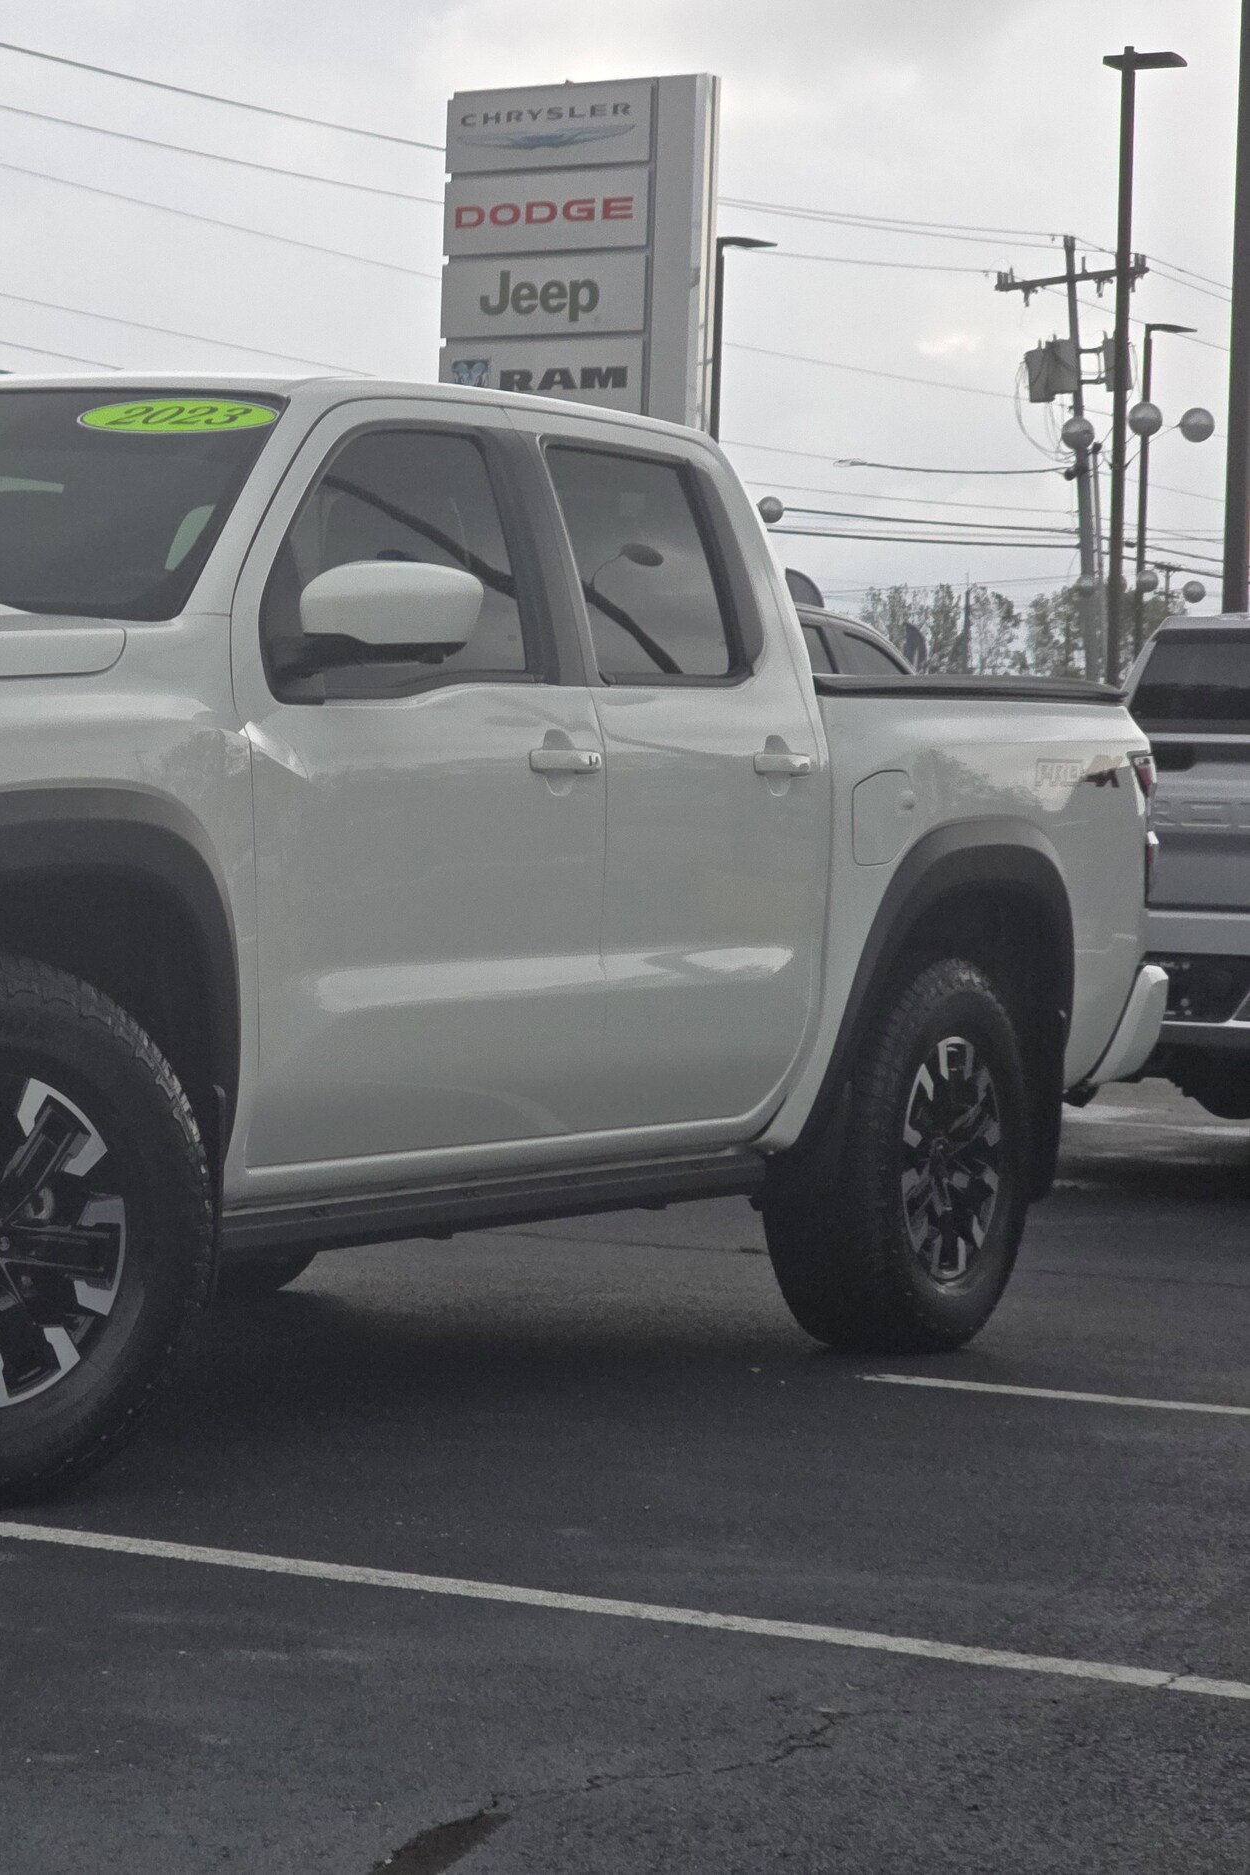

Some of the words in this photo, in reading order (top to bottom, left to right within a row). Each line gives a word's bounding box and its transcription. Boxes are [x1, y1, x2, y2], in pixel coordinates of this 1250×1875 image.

[460, 102, 632, 127] CHRYSLER
[455, 195, 634, 229] DODGE
[480, 270, 599, 322] Jeep
[499, 366, 629, 391] RAM
[105, 405, 253, 426] 2023
